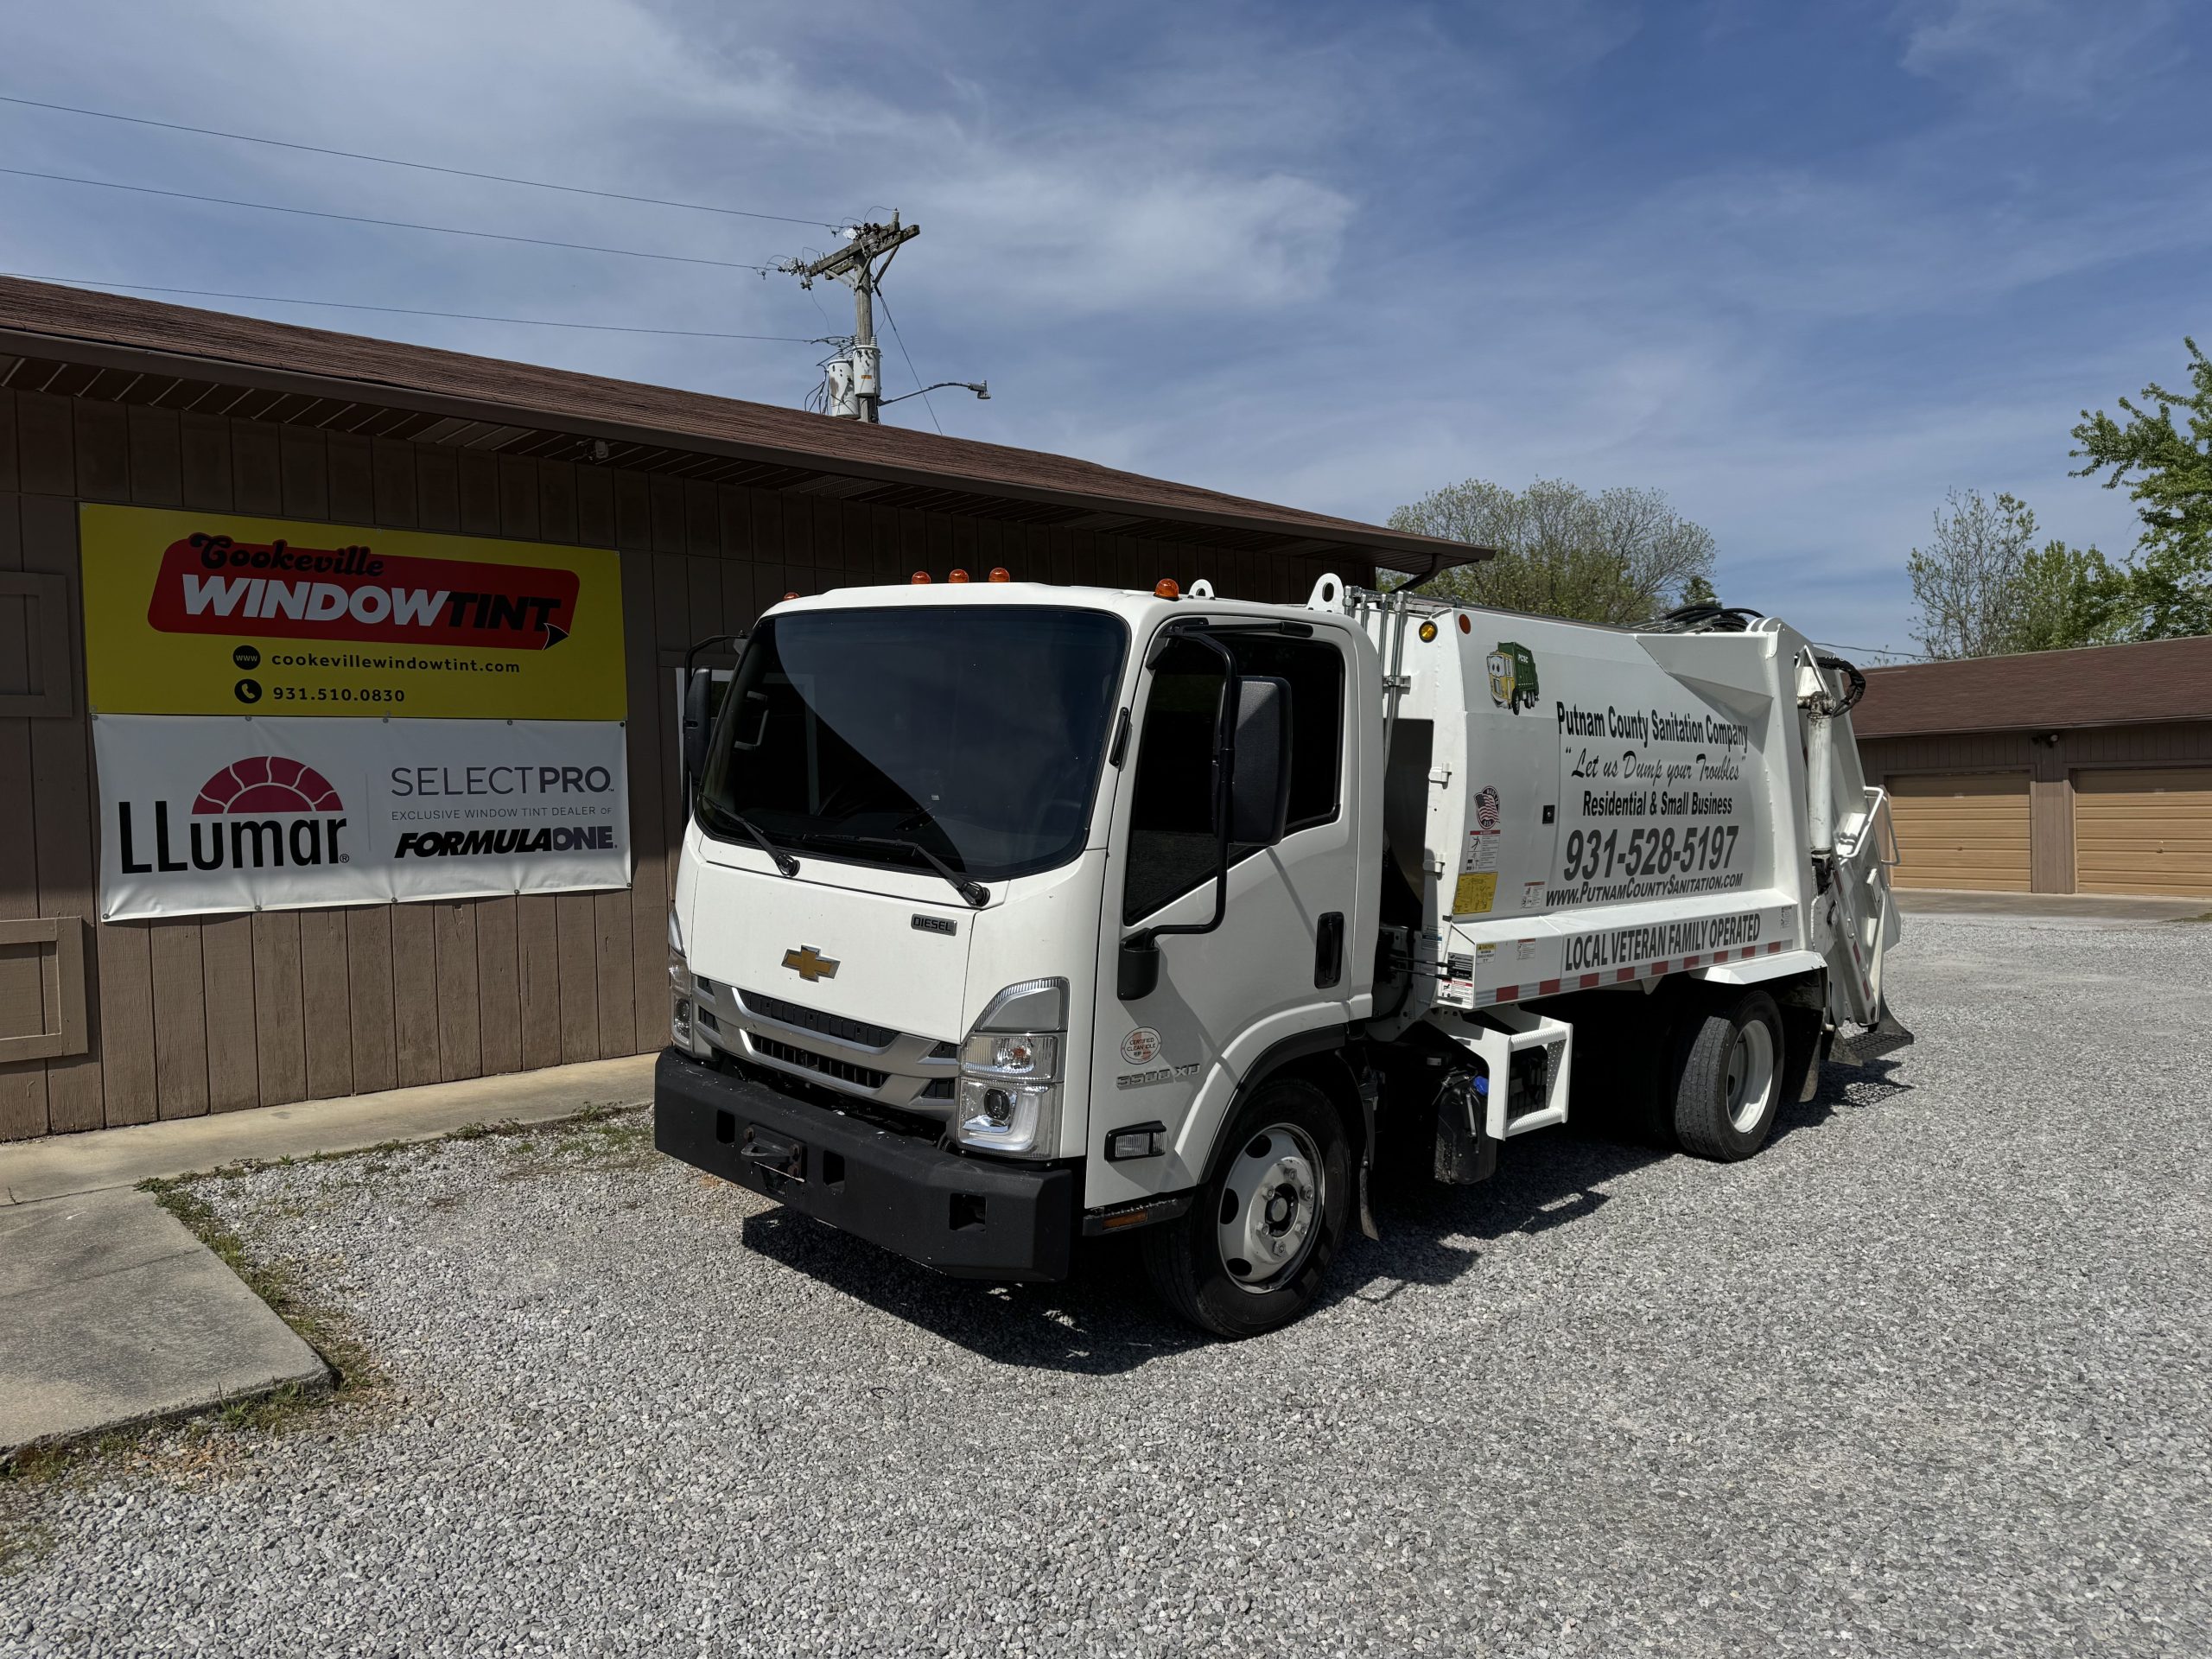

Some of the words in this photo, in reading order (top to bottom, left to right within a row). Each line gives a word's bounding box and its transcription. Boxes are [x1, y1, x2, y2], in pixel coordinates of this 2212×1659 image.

[189, 532, 384, 576] Cookeville
[271, 652, 520, 673] cookevillewindowtint.com
[273, 686, 405, 702] 931.510.0830
[1556, 701, 1606, 737] Putnam
[1608, 705, 1649, 748] County
[1651, 709, 1705, 744] Sanitation
[1706, 715, 1748, 753] Company
[1603, 760, 1619, 778] us
[1623, 750, 1663, 787] Dump
[1667, 766, 1693, 787] your
[391, 810, 461, 821] EXCLUSIVE
[464, 808, 518, 819] WINDOW
[521, 807, 549, 817] TINT
[551, 806, 596, 817] DEALER
[1583, 791, 1646, 817] Residential
[1649, 791, 1658, 816] &
[1661, 791, 1689, 816] Small
[1691, 791, 1732, 816] Business
[118, 800, 347, 874] LLumar
[1564, 825, 1739, 881] 931-528-5197
[913, 917, 951, 931] DIESEL
[1565, 933, 1608, 971] LOCAL
[1611, 925, 1668, 964] VETERAN
[1668, 920, 1708, 955] FAMILY
[1709, 912, 1761, 949] OPERATED
[1129, 1037, 1154, 1046] CERTIFIED
